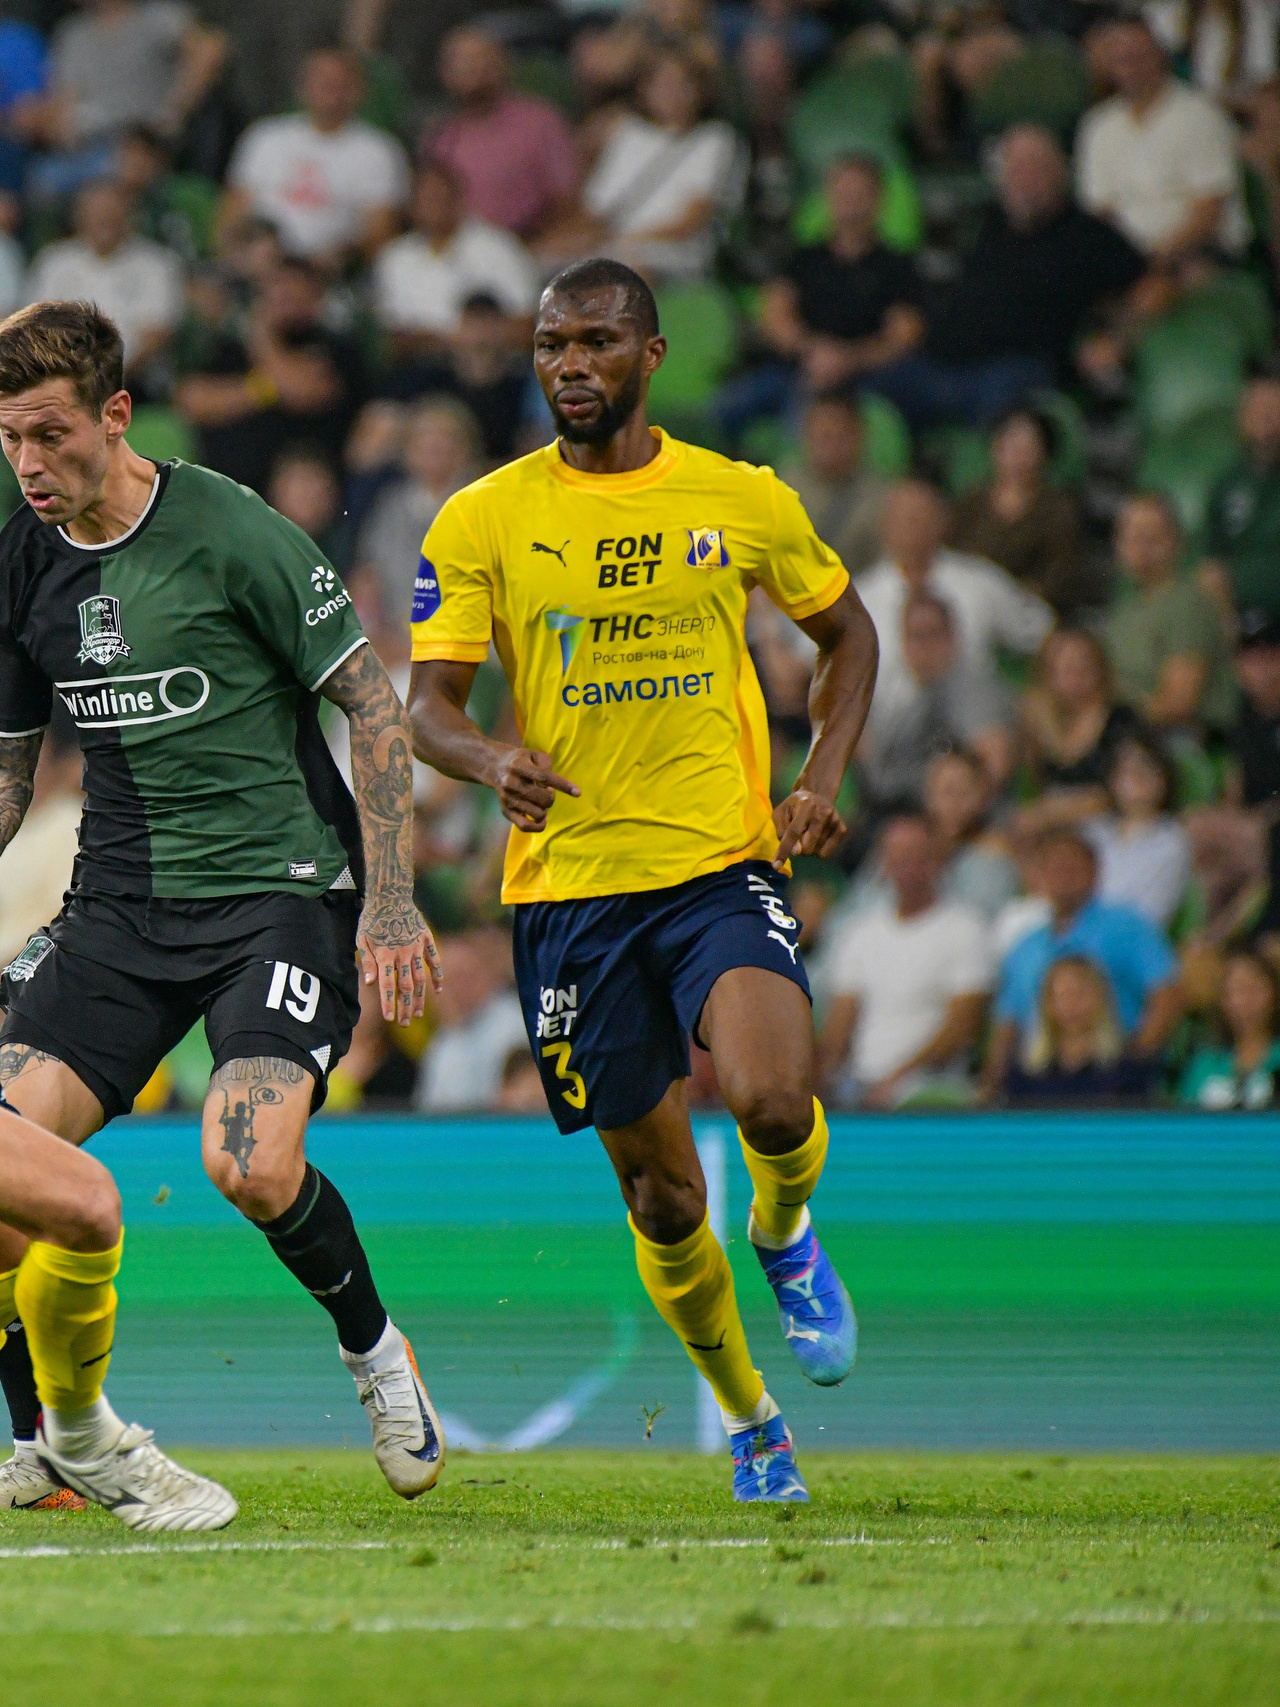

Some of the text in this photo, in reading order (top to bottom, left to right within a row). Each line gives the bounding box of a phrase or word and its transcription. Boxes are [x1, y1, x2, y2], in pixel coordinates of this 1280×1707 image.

[595, 533, 662, 561] FON
[598, 560, 662, 588] BET
[305, 588, 353, 626] Const
[589, 613, 716, 643] ТНС ЭНЕРГО
[592, 645, 706, 665] Ростов-на-Дону
[58, 688, 154, 717] Winline
[561, 672, 715, 707] самолет
[265, 960, 321, 1023] 19
[539, 984, 578, 1014] ON
[541, 1040, 587, 1110] 3
